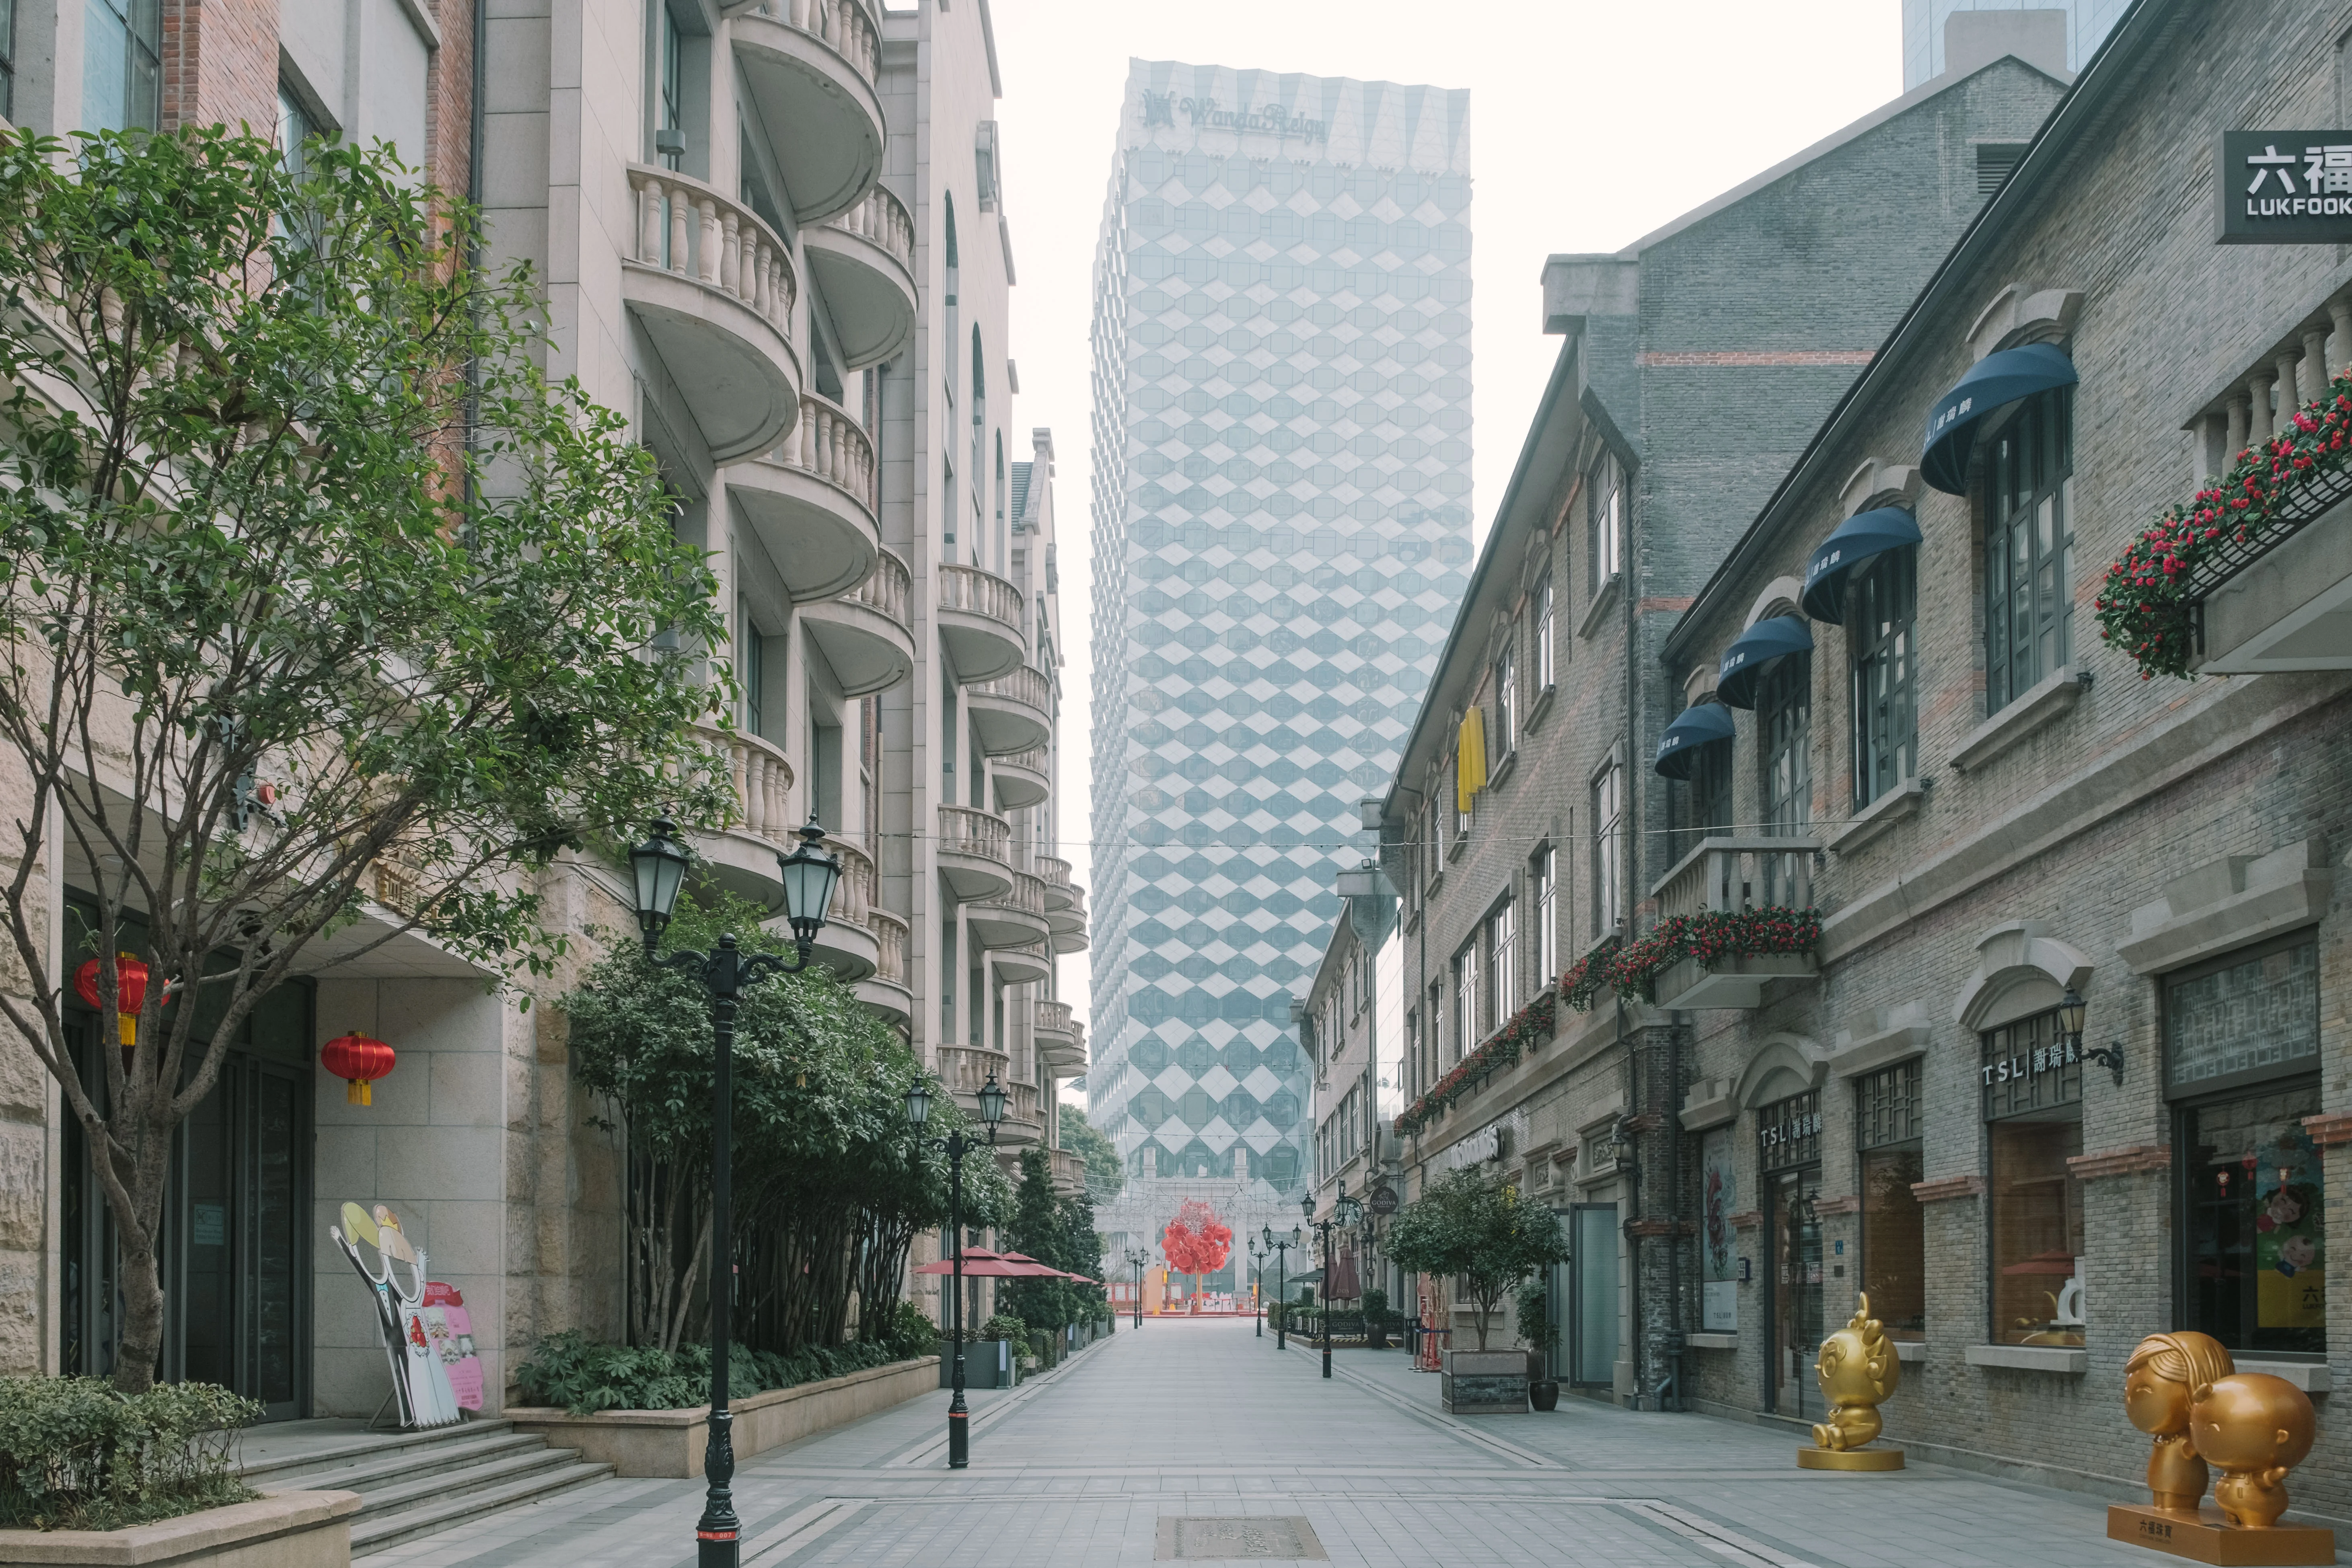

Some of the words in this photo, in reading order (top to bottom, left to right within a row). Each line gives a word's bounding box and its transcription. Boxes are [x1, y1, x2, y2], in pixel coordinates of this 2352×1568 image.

[1180, 97, 1260, 129] Wanda
[1262, 103, 1326, 144] Reign
[2247, 145, 2352, 195] 六福
[2247, 198, 2352, 216] LUKFOOK
[1982, 1057, 2023, 1085] TSL
[1761, 1124, 1786, 1147] TSL
[1792, 1112, 1822, 1139] 謝瑞麟
[2303, 1286, 2325, 1303] 六
